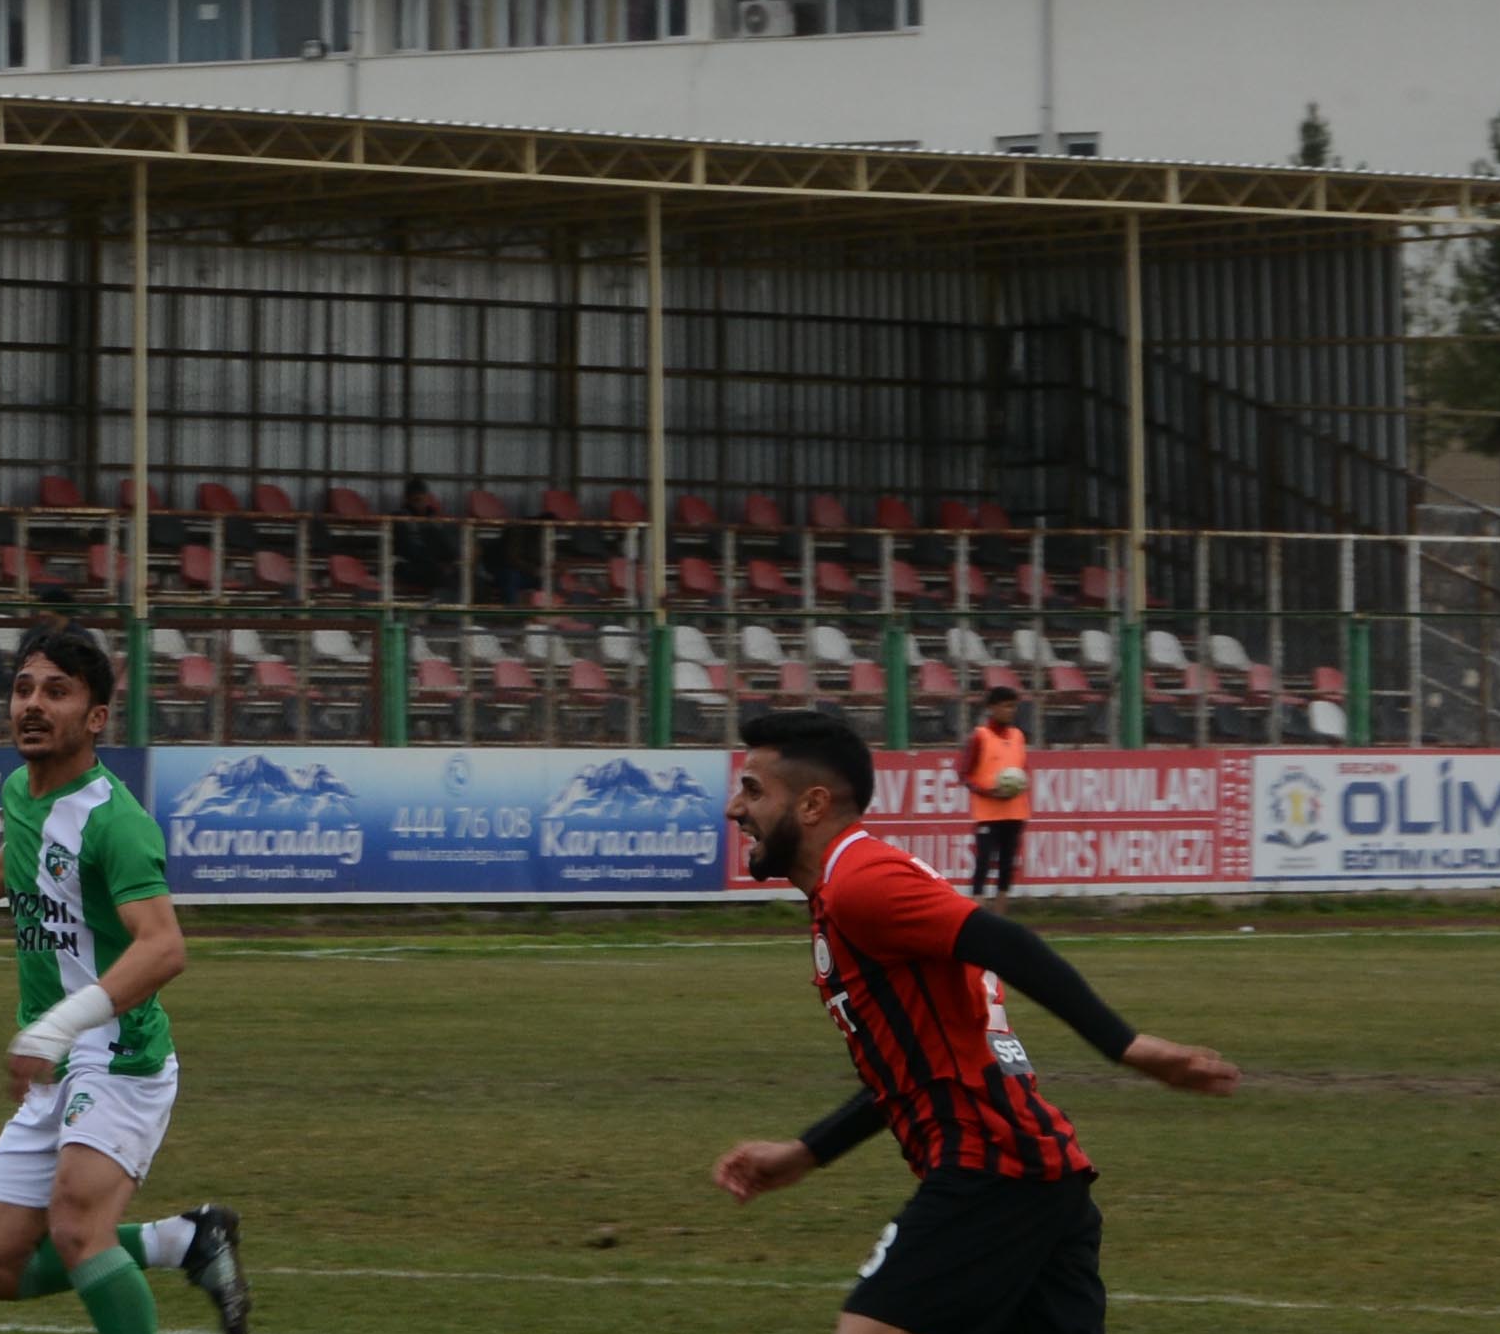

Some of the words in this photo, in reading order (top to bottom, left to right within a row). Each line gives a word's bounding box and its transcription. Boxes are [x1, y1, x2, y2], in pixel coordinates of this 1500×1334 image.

[1033, 768, 1219, 813] KURUMLARI
[169, 819, 364, 865] Karacadağ
[540, 820, 718, 865] Karacadağ
[1023, 830, 1098, 878] KURS
[1101, 829, 1215, 877] MERKEZİ
